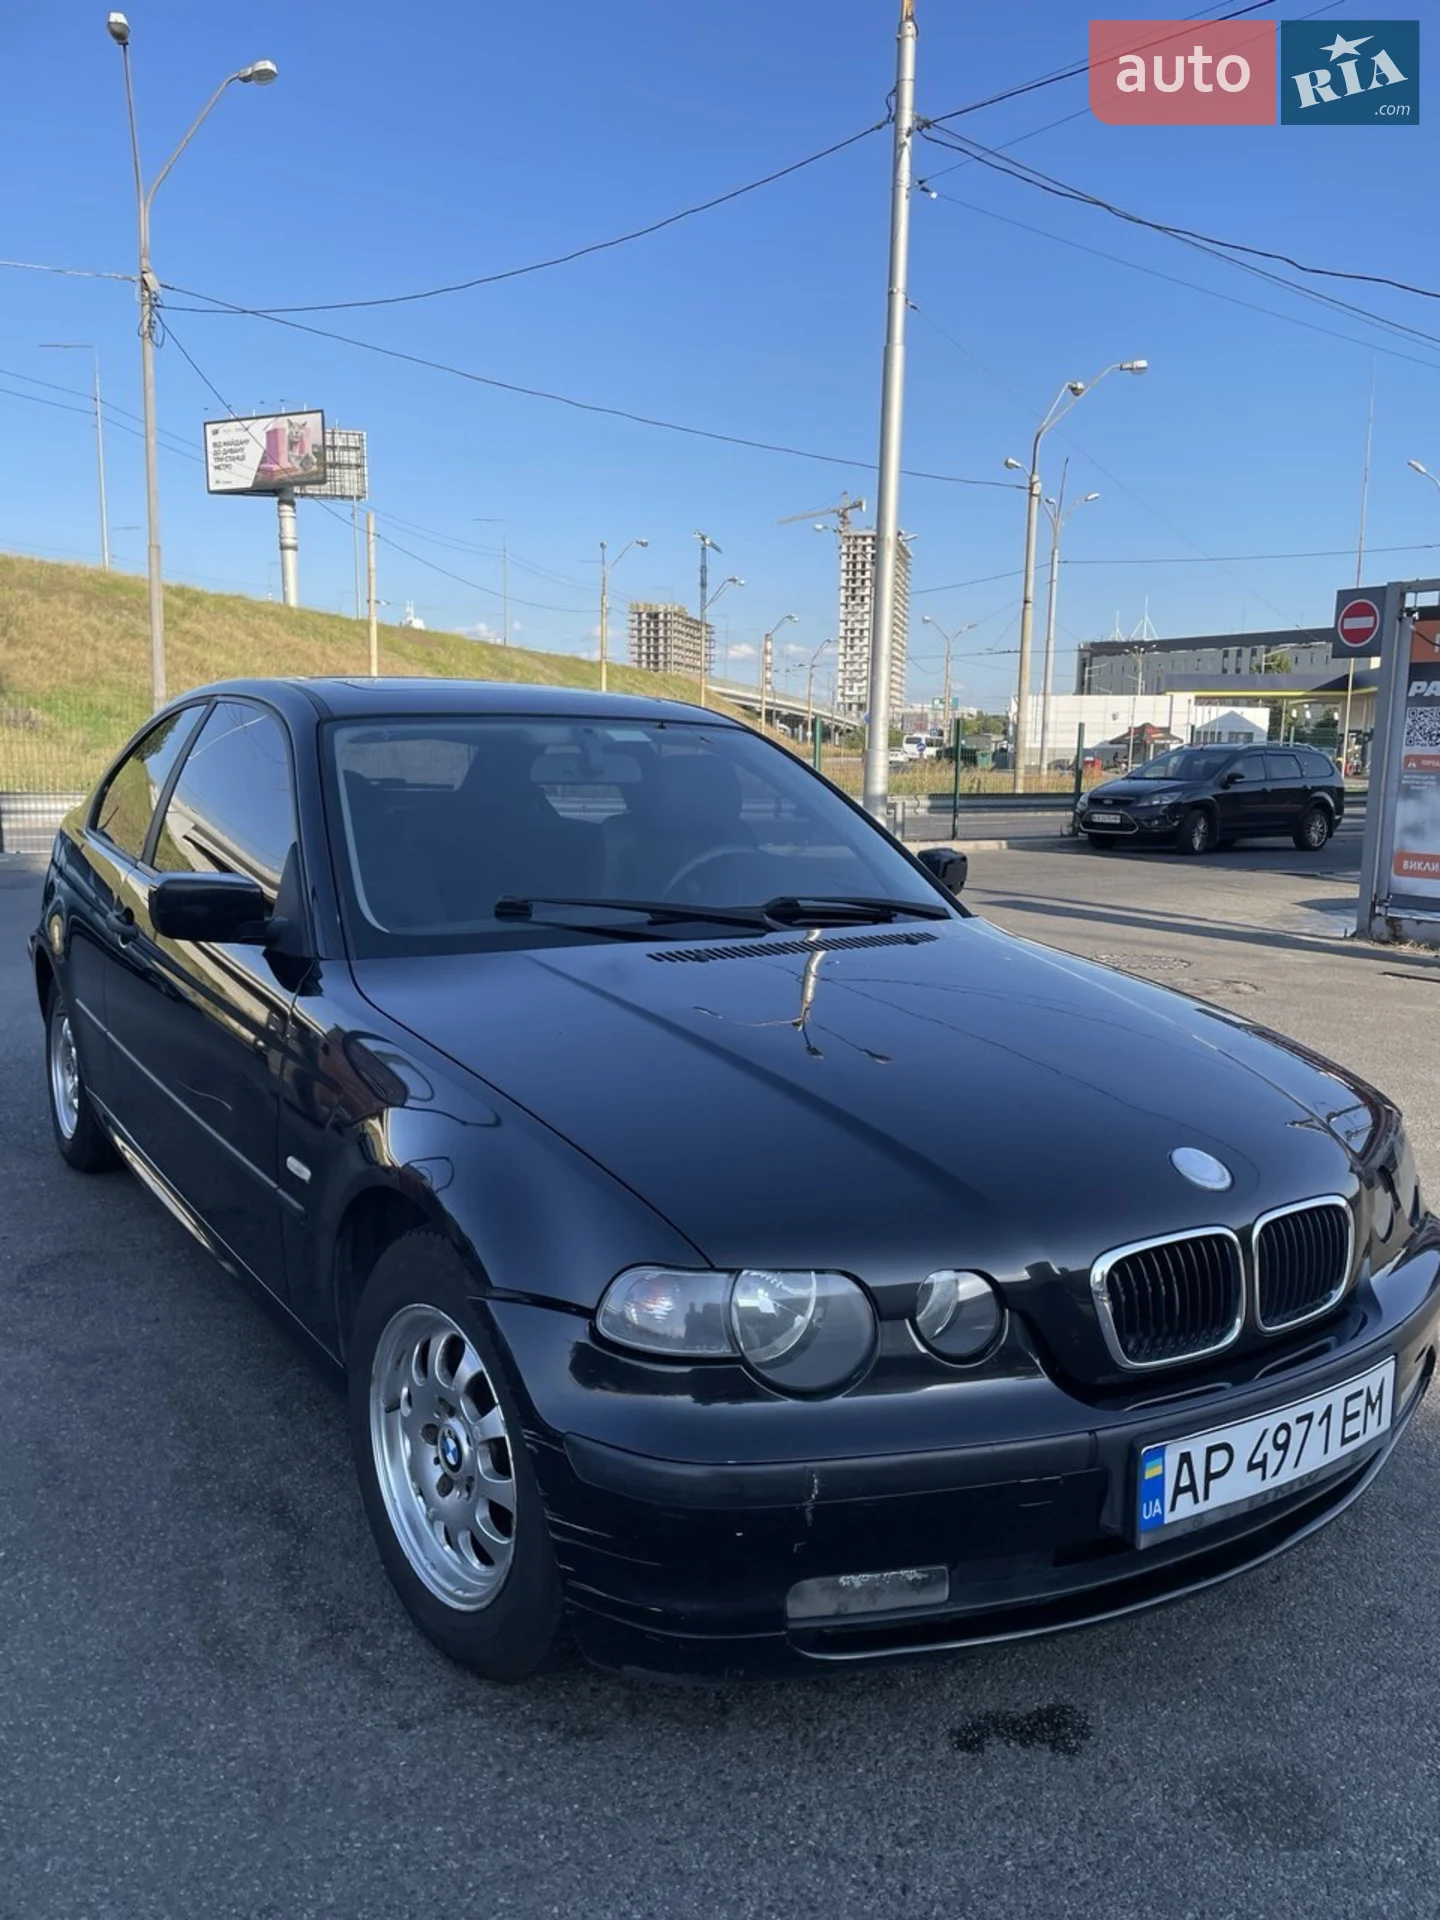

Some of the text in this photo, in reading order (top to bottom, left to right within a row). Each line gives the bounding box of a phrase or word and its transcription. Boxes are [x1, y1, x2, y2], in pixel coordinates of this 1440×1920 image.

[1169, 1442, 1235, 1512] AP
[1246, 1403, 1333, 1482] 4971
[1340, 1375, 1386, 1447] EM
[1142, 1504, 1162, 1520] UA
